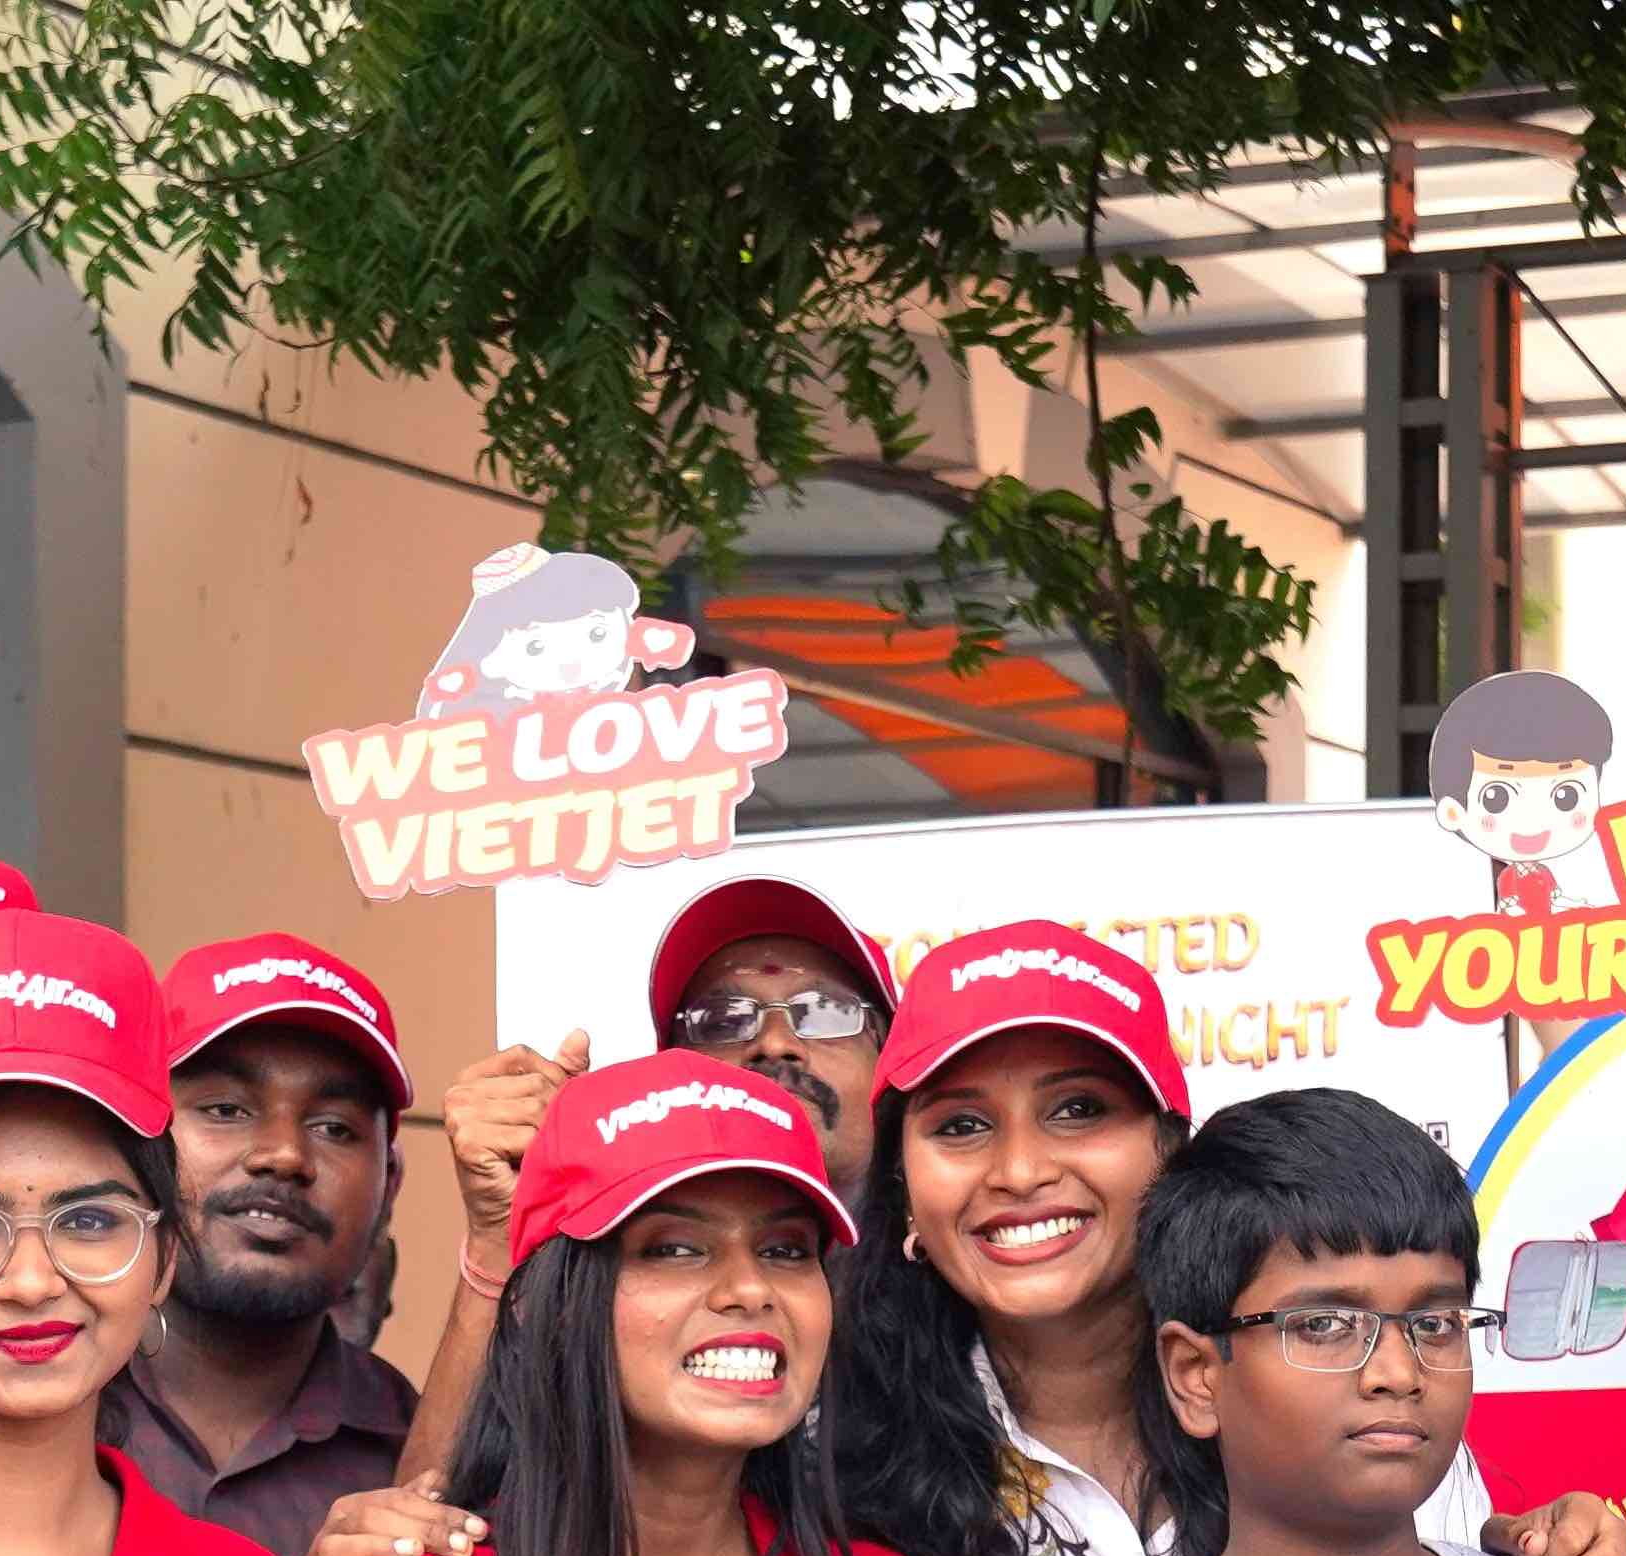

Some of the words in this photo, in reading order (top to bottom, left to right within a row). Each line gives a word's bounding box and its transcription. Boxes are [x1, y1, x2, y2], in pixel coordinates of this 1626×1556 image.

[317, 721, 487, 806] WE
[513, 678, 774, 782] LOVE
[353, 768, 739, 887] VIETJET
